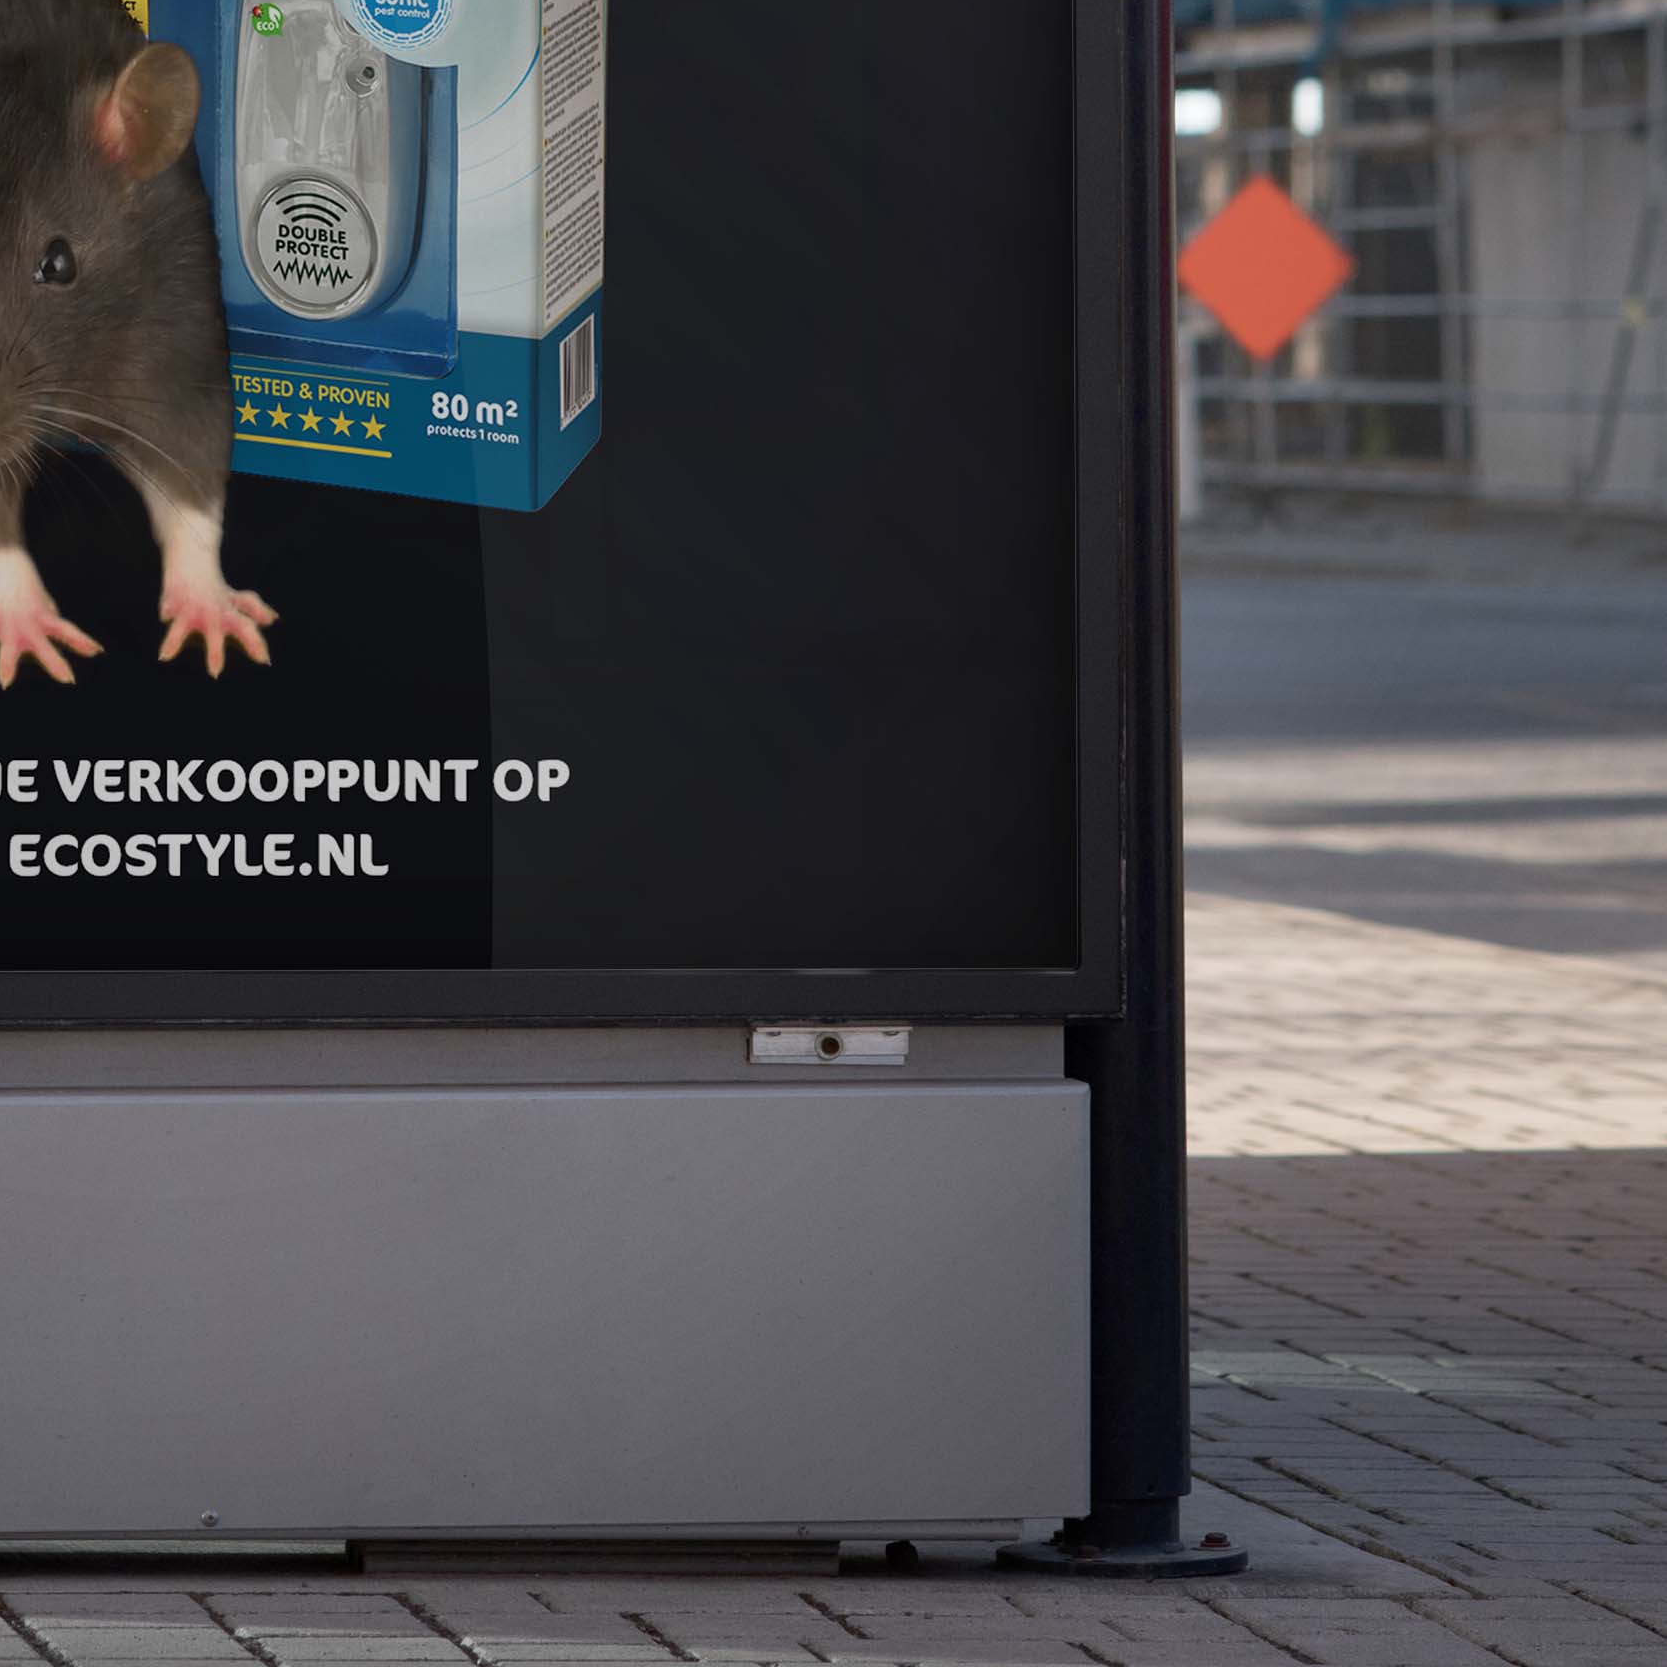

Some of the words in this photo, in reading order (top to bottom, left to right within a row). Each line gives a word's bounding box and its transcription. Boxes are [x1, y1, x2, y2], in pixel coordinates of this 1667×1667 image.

[374, 8, 395, 17] pest
[397, 9, 430, 19] control
[256, 22, 274, 31] ECO
[278, 224, 347, 245] DOUBLE
[275, 239, 350, 260] PROTECT
[232, 374, 294, 398] TESTED
[299, 382, 313, 400] &
[317, 385, 391, 409] PROVEN
[431, 391, 469, 422] 80
[426, 423, 478, 440] protects
[479, 428, 485, 441] 1
[486, 431, 520, 444] room
[53, 759, 479, 803] VERKOOPPUNT
[492, 759, 570, 802] OP
[9, 833, 390, 877] ECOSTYLE.NL
